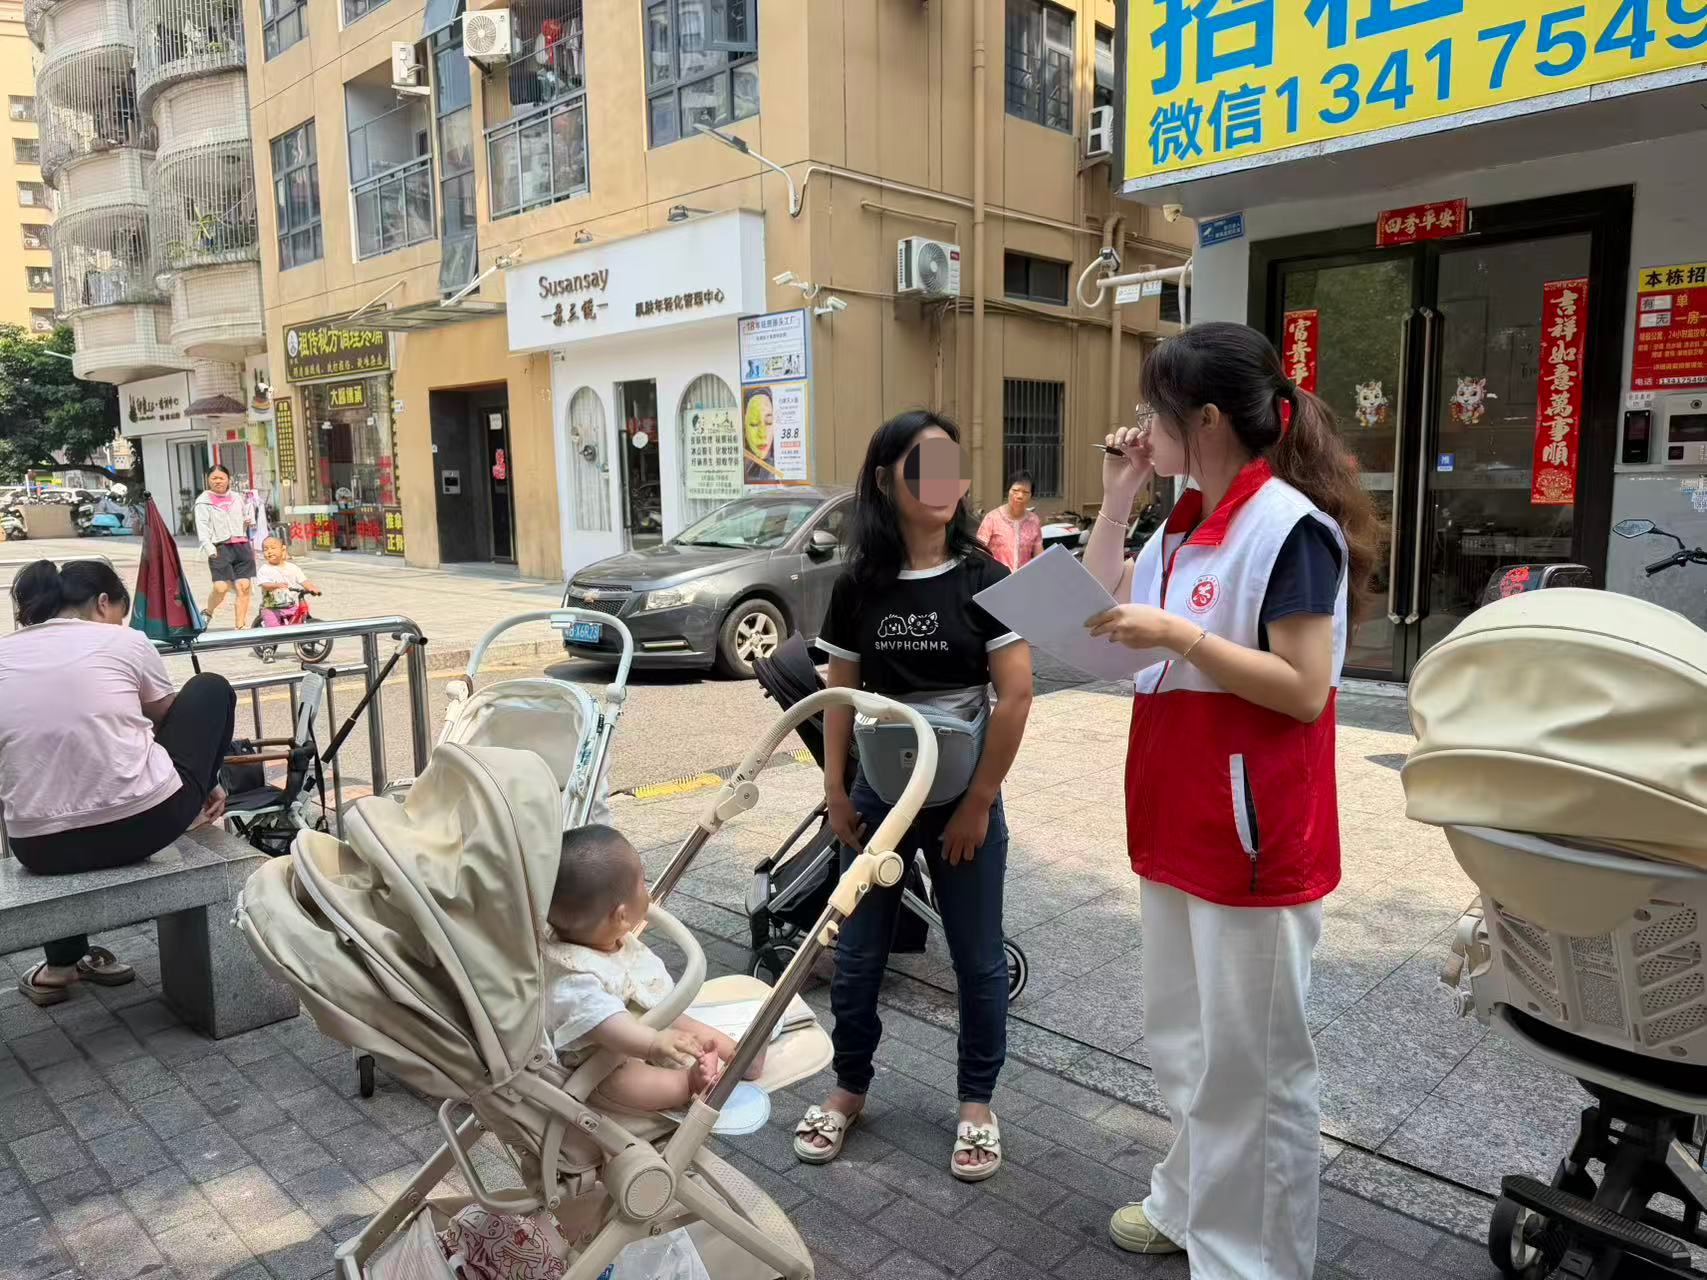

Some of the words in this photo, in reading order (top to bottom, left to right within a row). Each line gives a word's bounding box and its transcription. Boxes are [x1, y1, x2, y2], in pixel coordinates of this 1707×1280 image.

[1385, 208, 1456, 235] 四季平安
[539, 268, 609, 299] Susansay
[1645, 267, 1706, 288] 本栋招
[780, 428, 799, 440] 38.8
[874, 640, 949, 651] SMVPHCNMR
